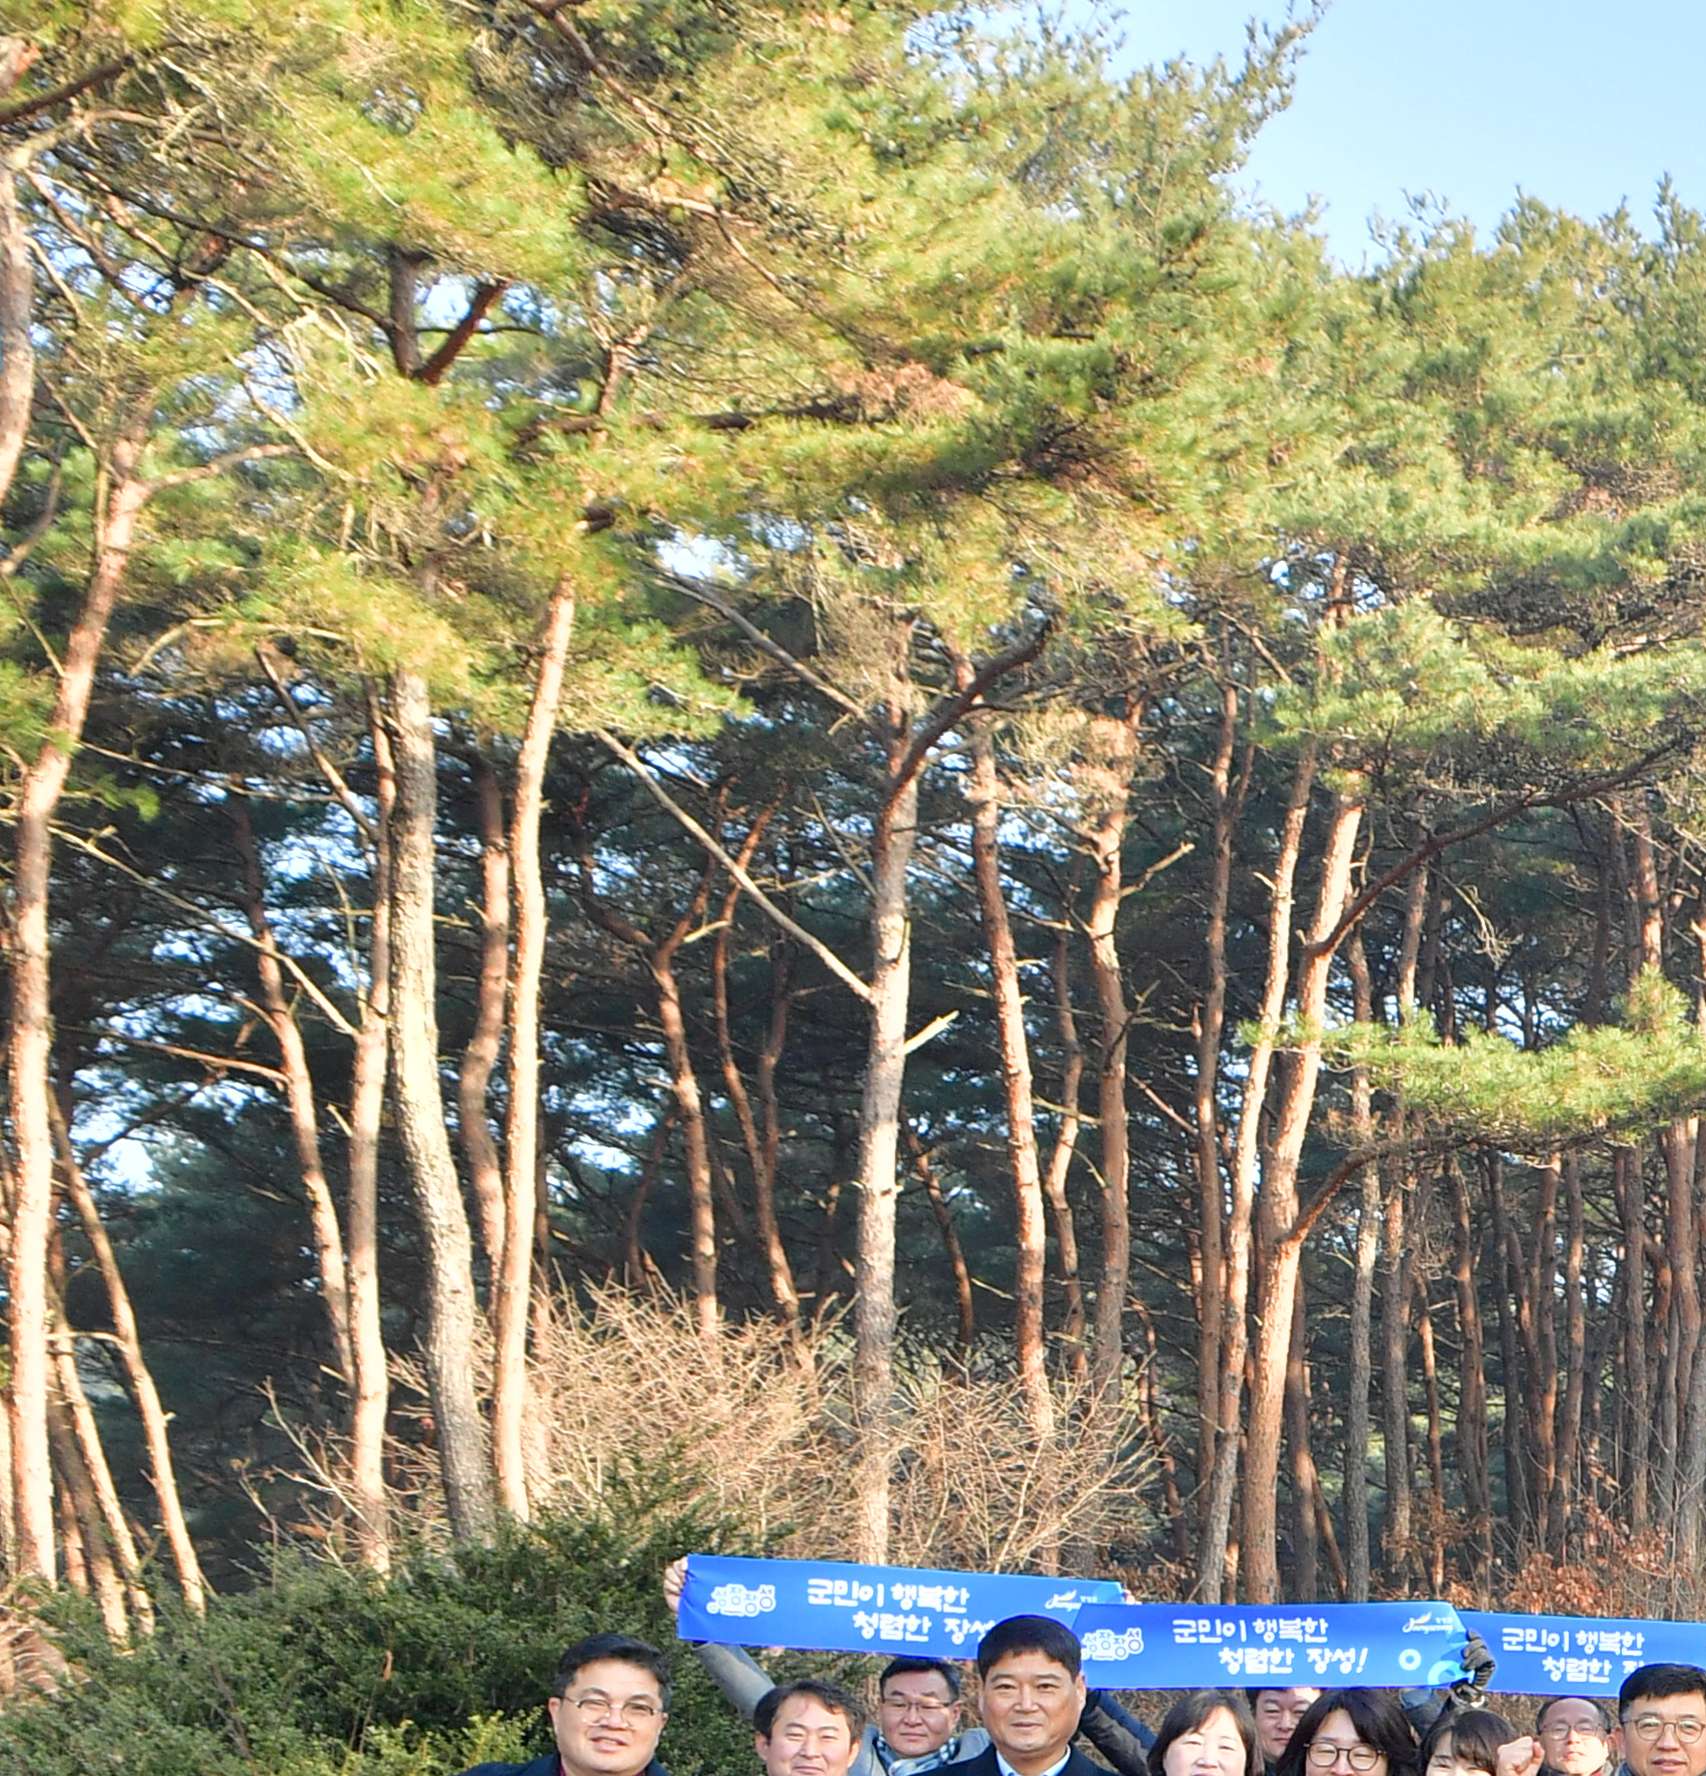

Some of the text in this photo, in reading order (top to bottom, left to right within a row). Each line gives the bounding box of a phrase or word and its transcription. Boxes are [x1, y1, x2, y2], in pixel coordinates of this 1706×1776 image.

[807, 1578, 970, 1614] 군민이 행복한
[853, 1611, 932, 1642] 청렴한
[1173, 1617, 1328, 1644] 군민이 행복한
[1502, 1627, 1645, 1657] 군민이 행복한
[1219, 1647, 1369, 1675] 청렴한 장성!
[1543, 1655, 1612, 1684] 청렴한
